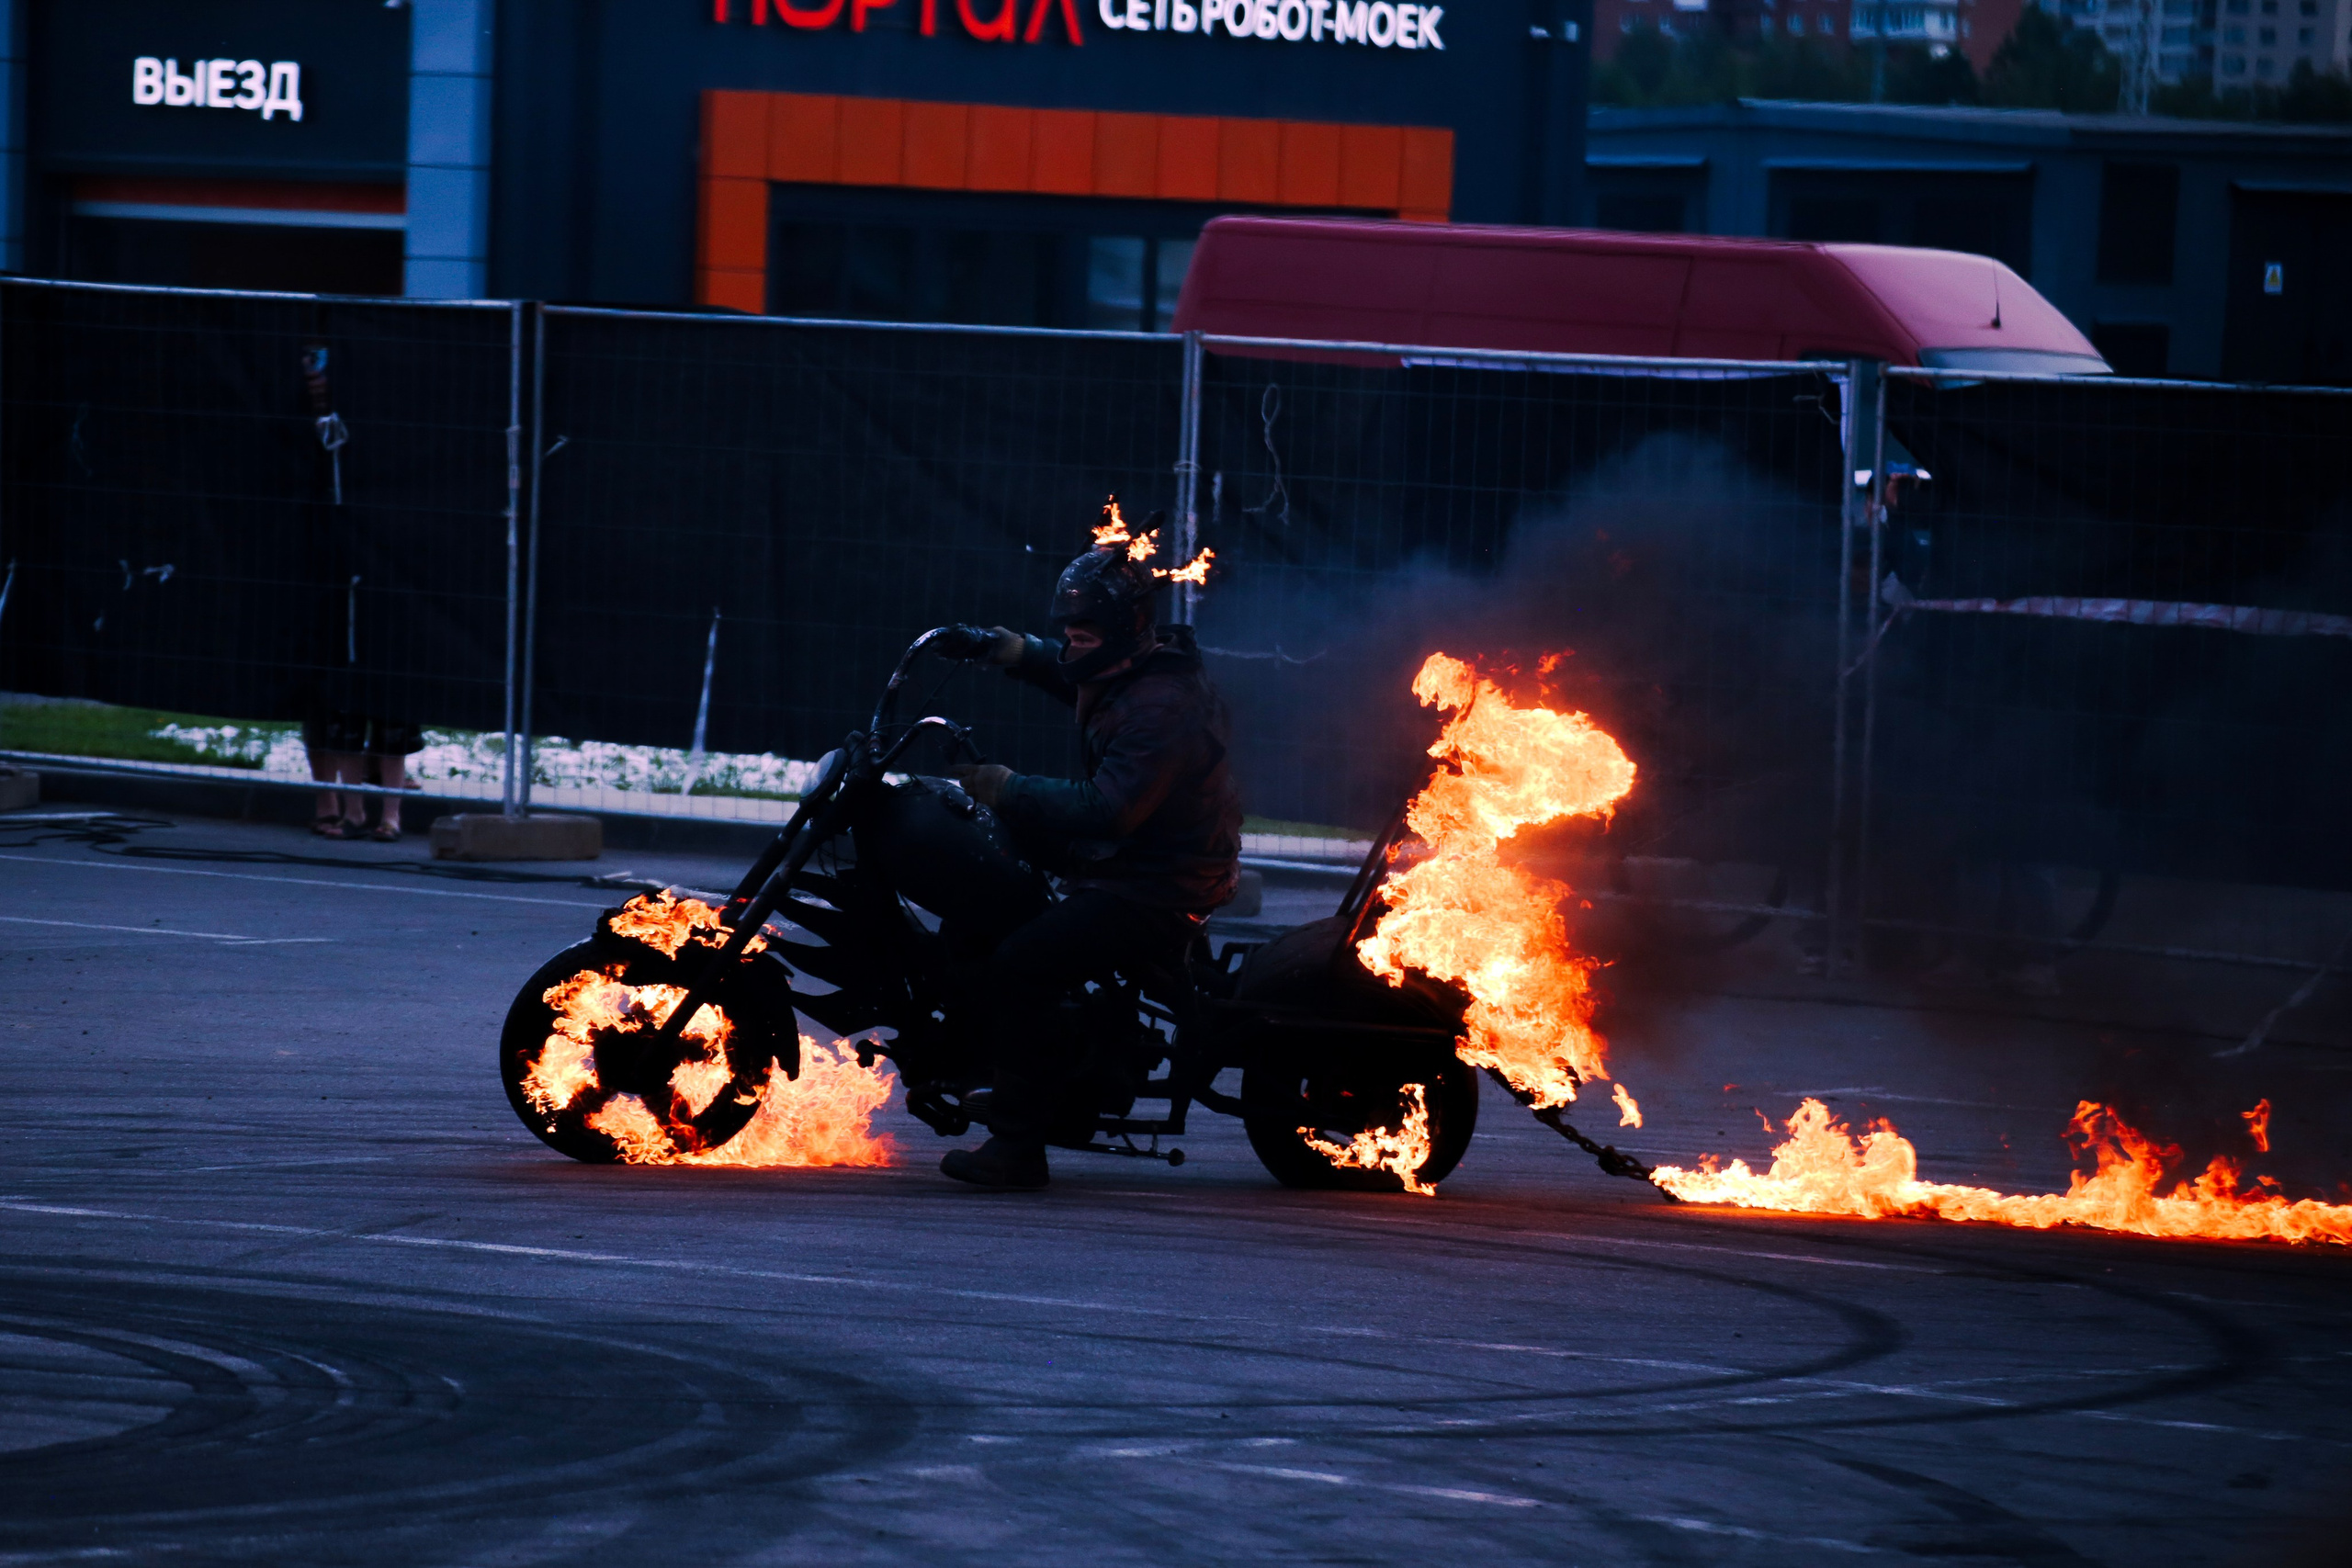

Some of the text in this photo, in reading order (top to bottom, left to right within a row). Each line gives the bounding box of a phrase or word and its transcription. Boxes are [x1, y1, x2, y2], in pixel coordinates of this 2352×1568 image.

[1098, 0, 1444, 50] СЕТЬ РОБОТ-МОЕК
[133, 56, 302, 121] ВЫЕЗД
